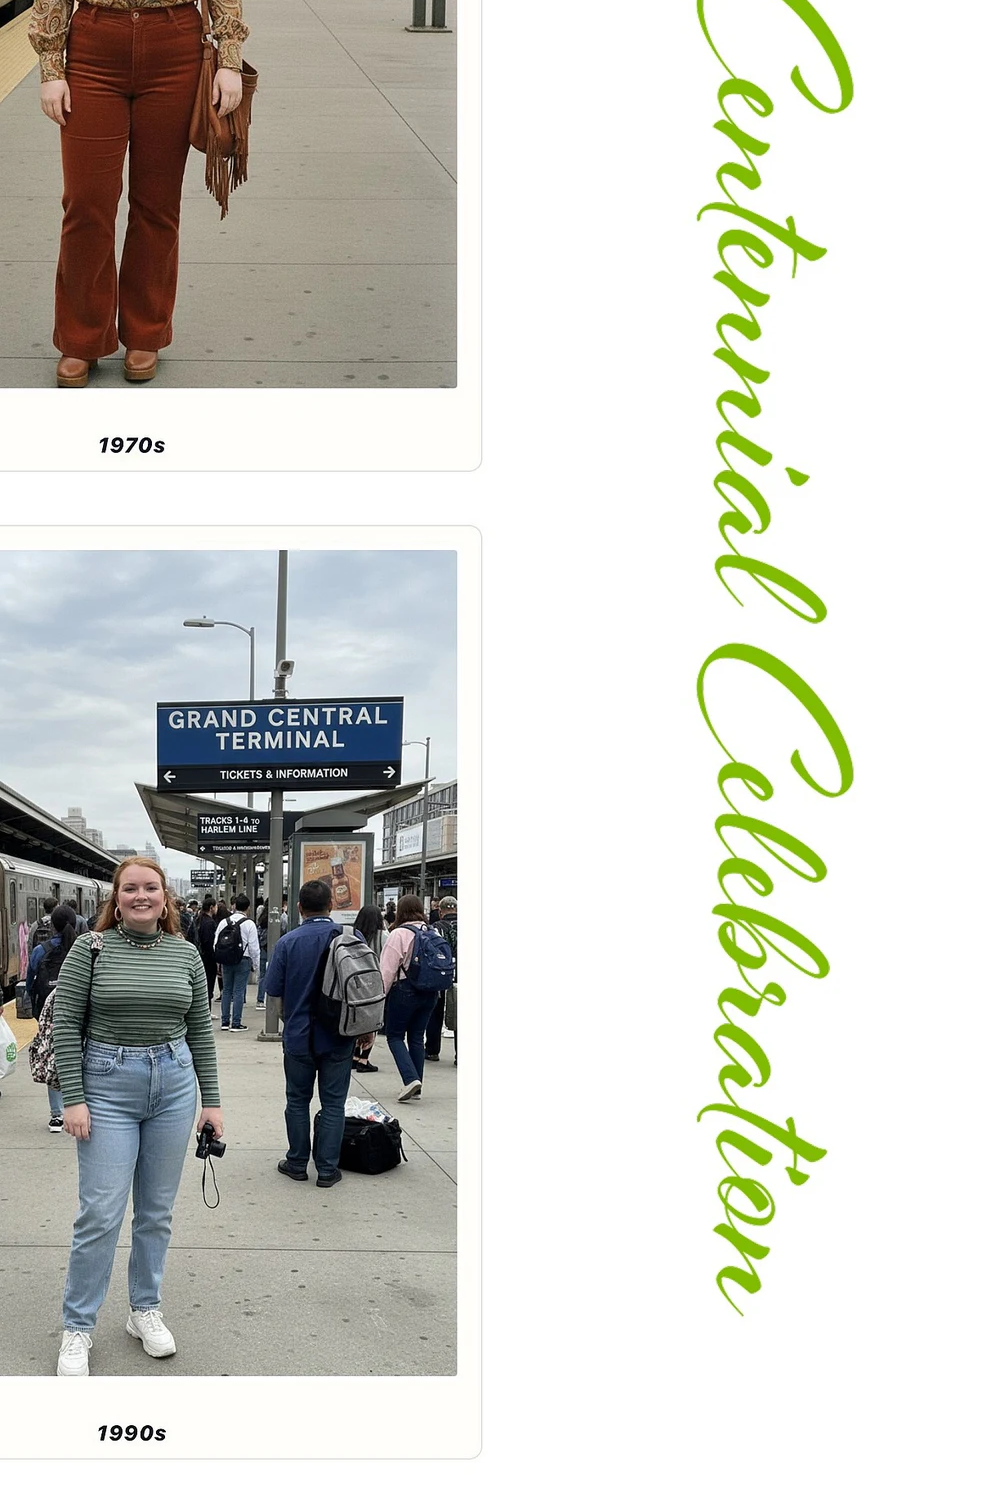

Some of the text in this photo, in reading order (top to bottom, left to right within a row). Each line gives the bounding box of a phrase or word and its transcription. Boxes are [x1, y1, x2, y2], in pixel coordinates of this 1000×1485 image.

[168, 706, 388, 729] GRAND CENTRAL
[215, 730, 345, 750] TERMINAL
[219, 768, 348, 780] TICKETS & INFORMATION
[199, 816, 233, 825] TRACKS
[200, 825, 258, 834] HARLEM LINE
